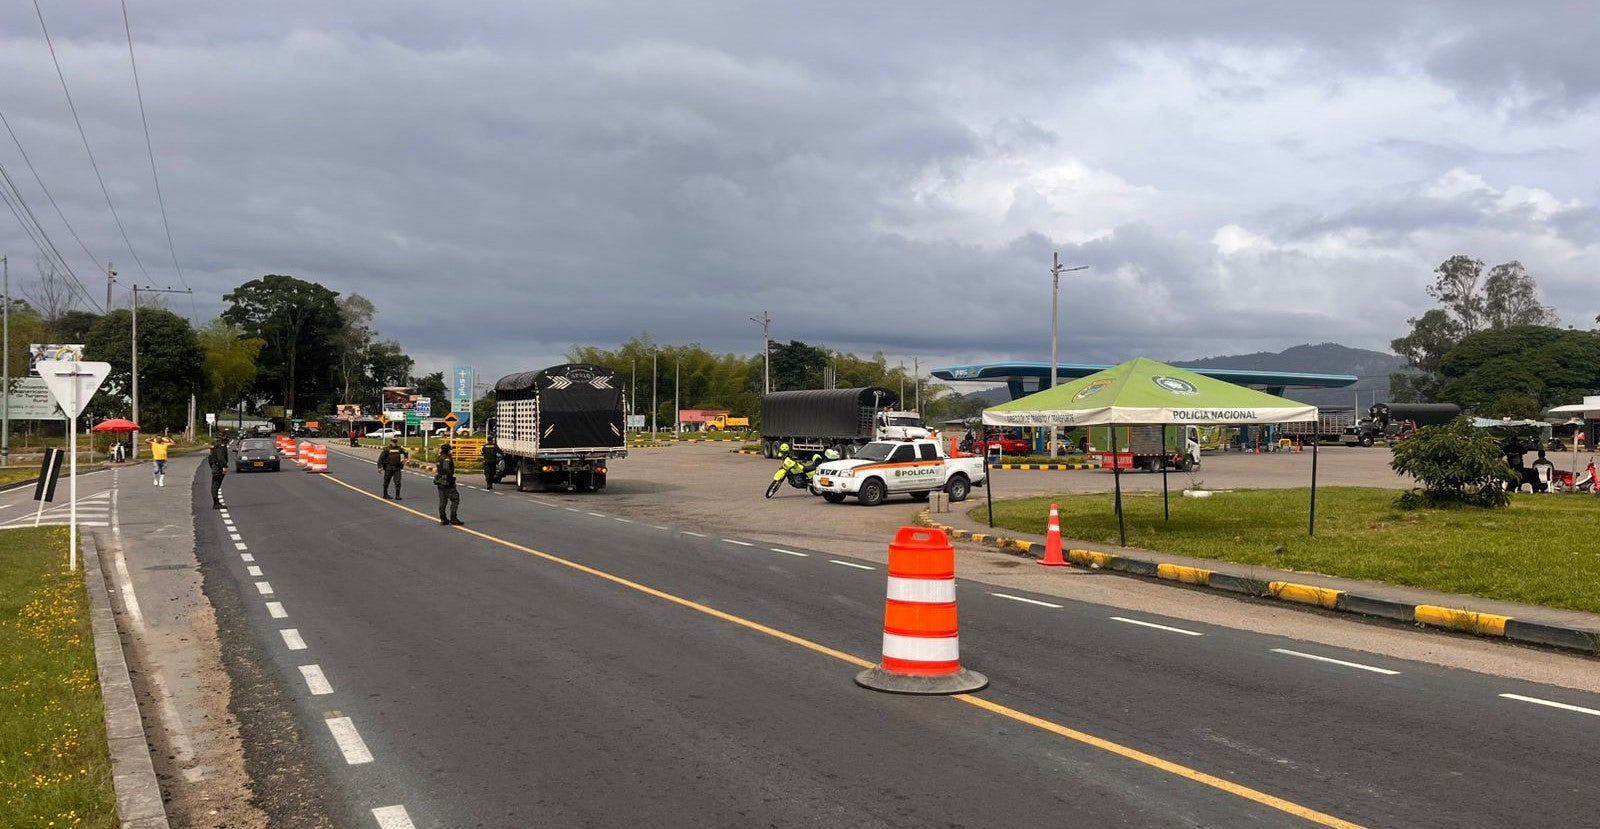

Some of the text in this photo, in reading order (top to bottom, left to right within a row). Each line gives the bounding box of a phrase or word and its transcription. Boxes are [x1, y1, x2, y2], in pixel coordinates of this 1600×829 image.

[458, 378, 466, 396] plus
[1173, 410, 1258, 420] POLICIA NACIONAL
[902, 468, 935, 477] POLICIA
